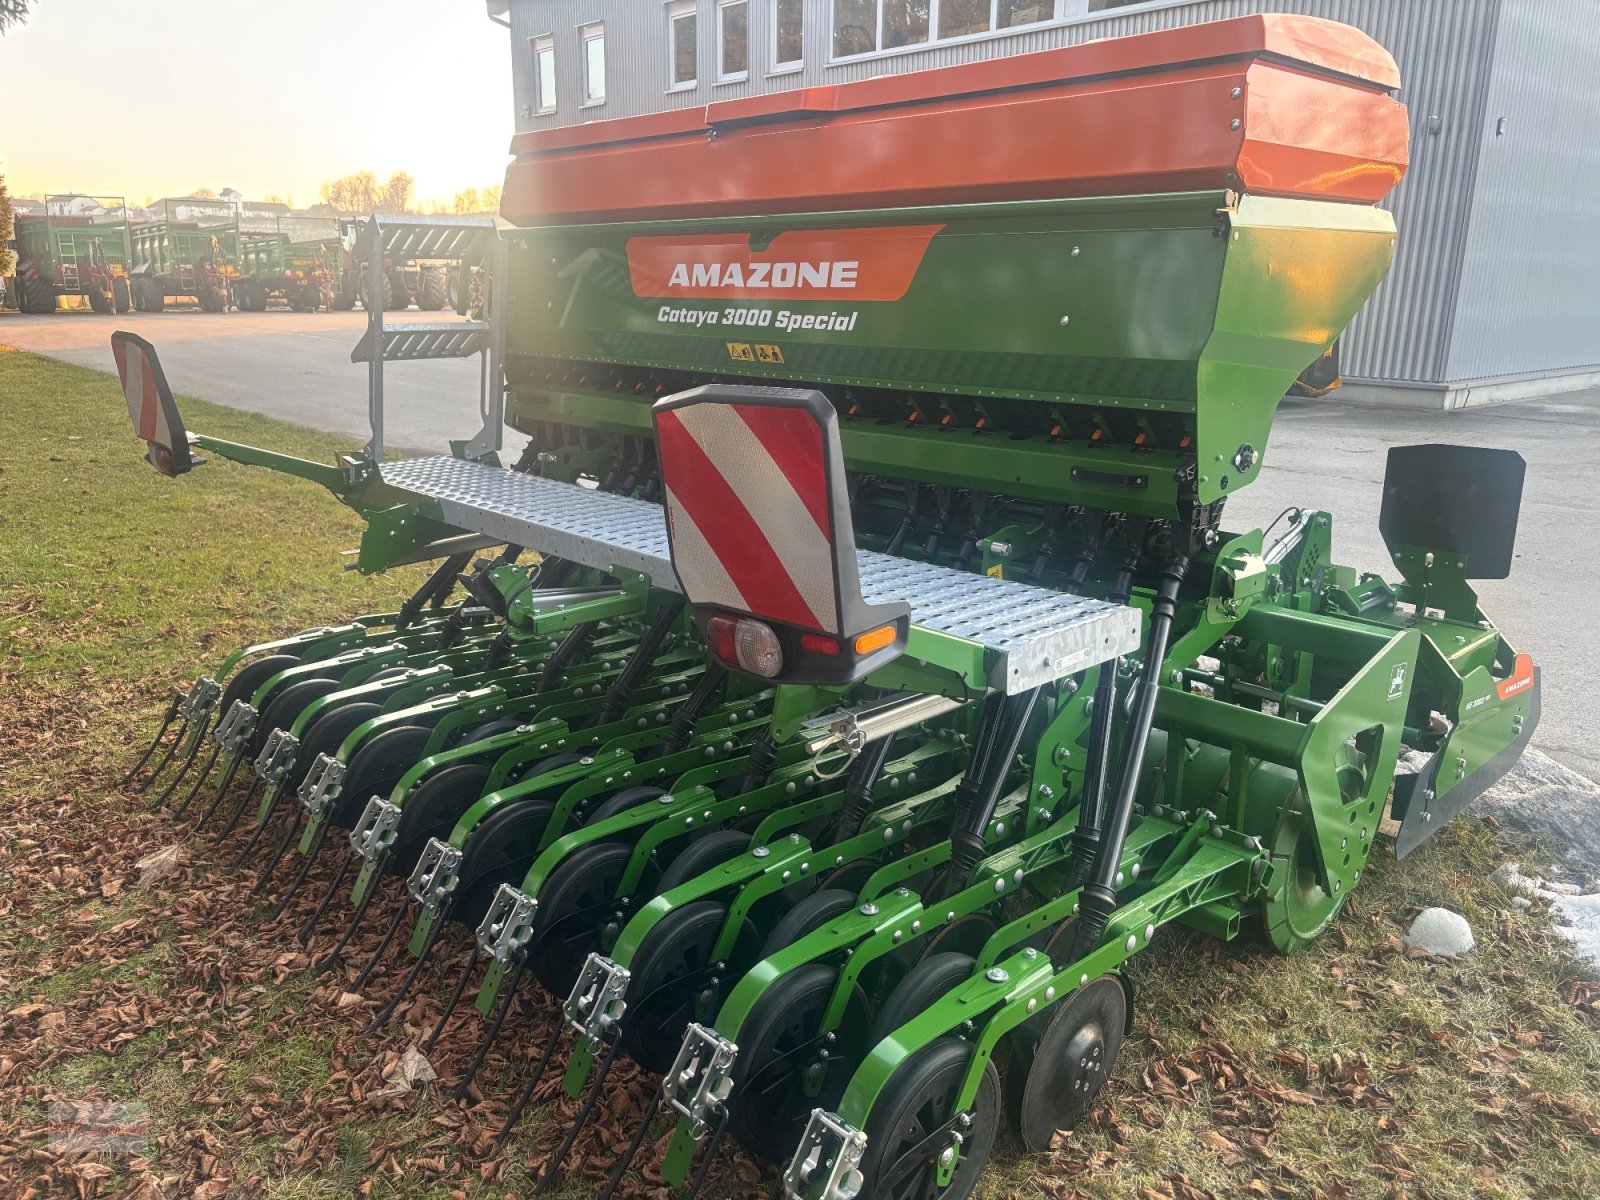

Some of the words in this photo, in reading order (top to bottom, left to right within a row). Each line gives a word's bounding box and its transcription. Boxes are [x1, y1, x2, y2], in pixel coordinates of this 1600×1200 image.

[668, 261, 859, 288] AMAZONE
[657, 306, 719, 327] Cataya
[722, 308, 772, 326] 3000
[775, 310, 858, 332] Special
